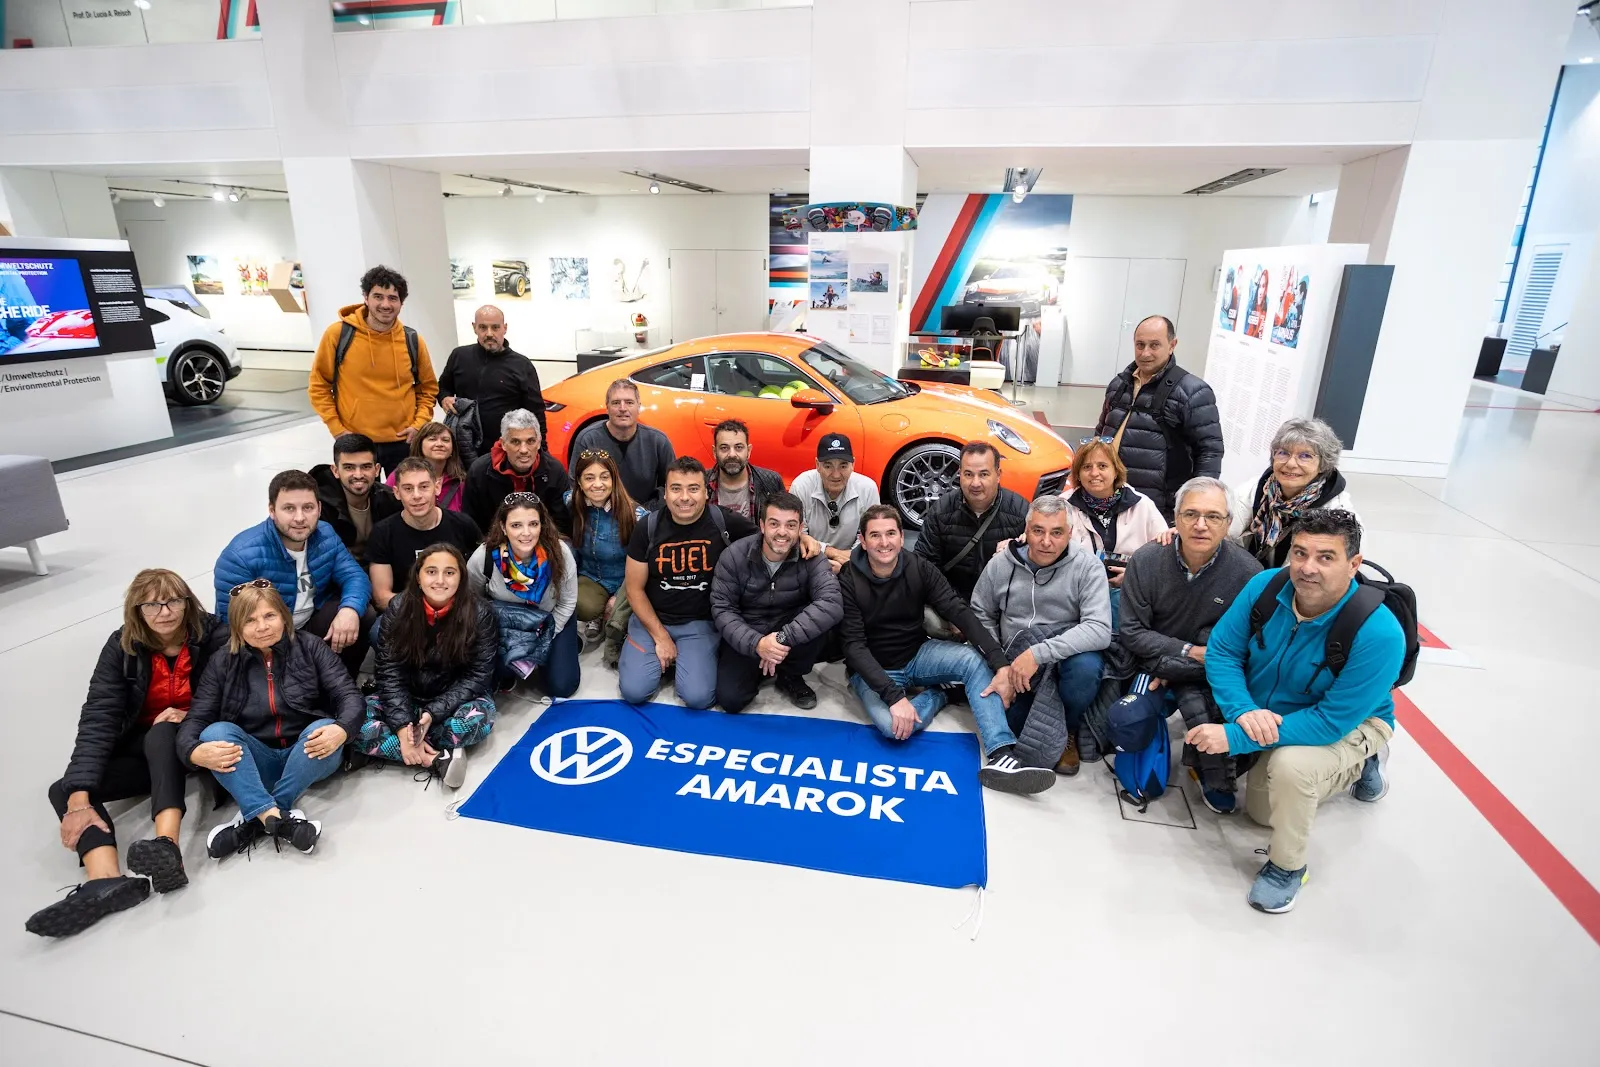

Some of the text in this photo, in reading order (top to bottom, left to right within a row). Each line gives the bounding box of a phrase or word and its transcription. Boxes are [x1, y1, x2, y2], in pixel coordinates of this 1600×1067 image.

[20, 304, 52, 318] RIDE
[63, 375, 101, 386] Protection
[655, 540, 713, 574] FUEL
[645, 738, 958, 795] ESPECIALISTA
[675, 774, 905, 823] AMAROK
